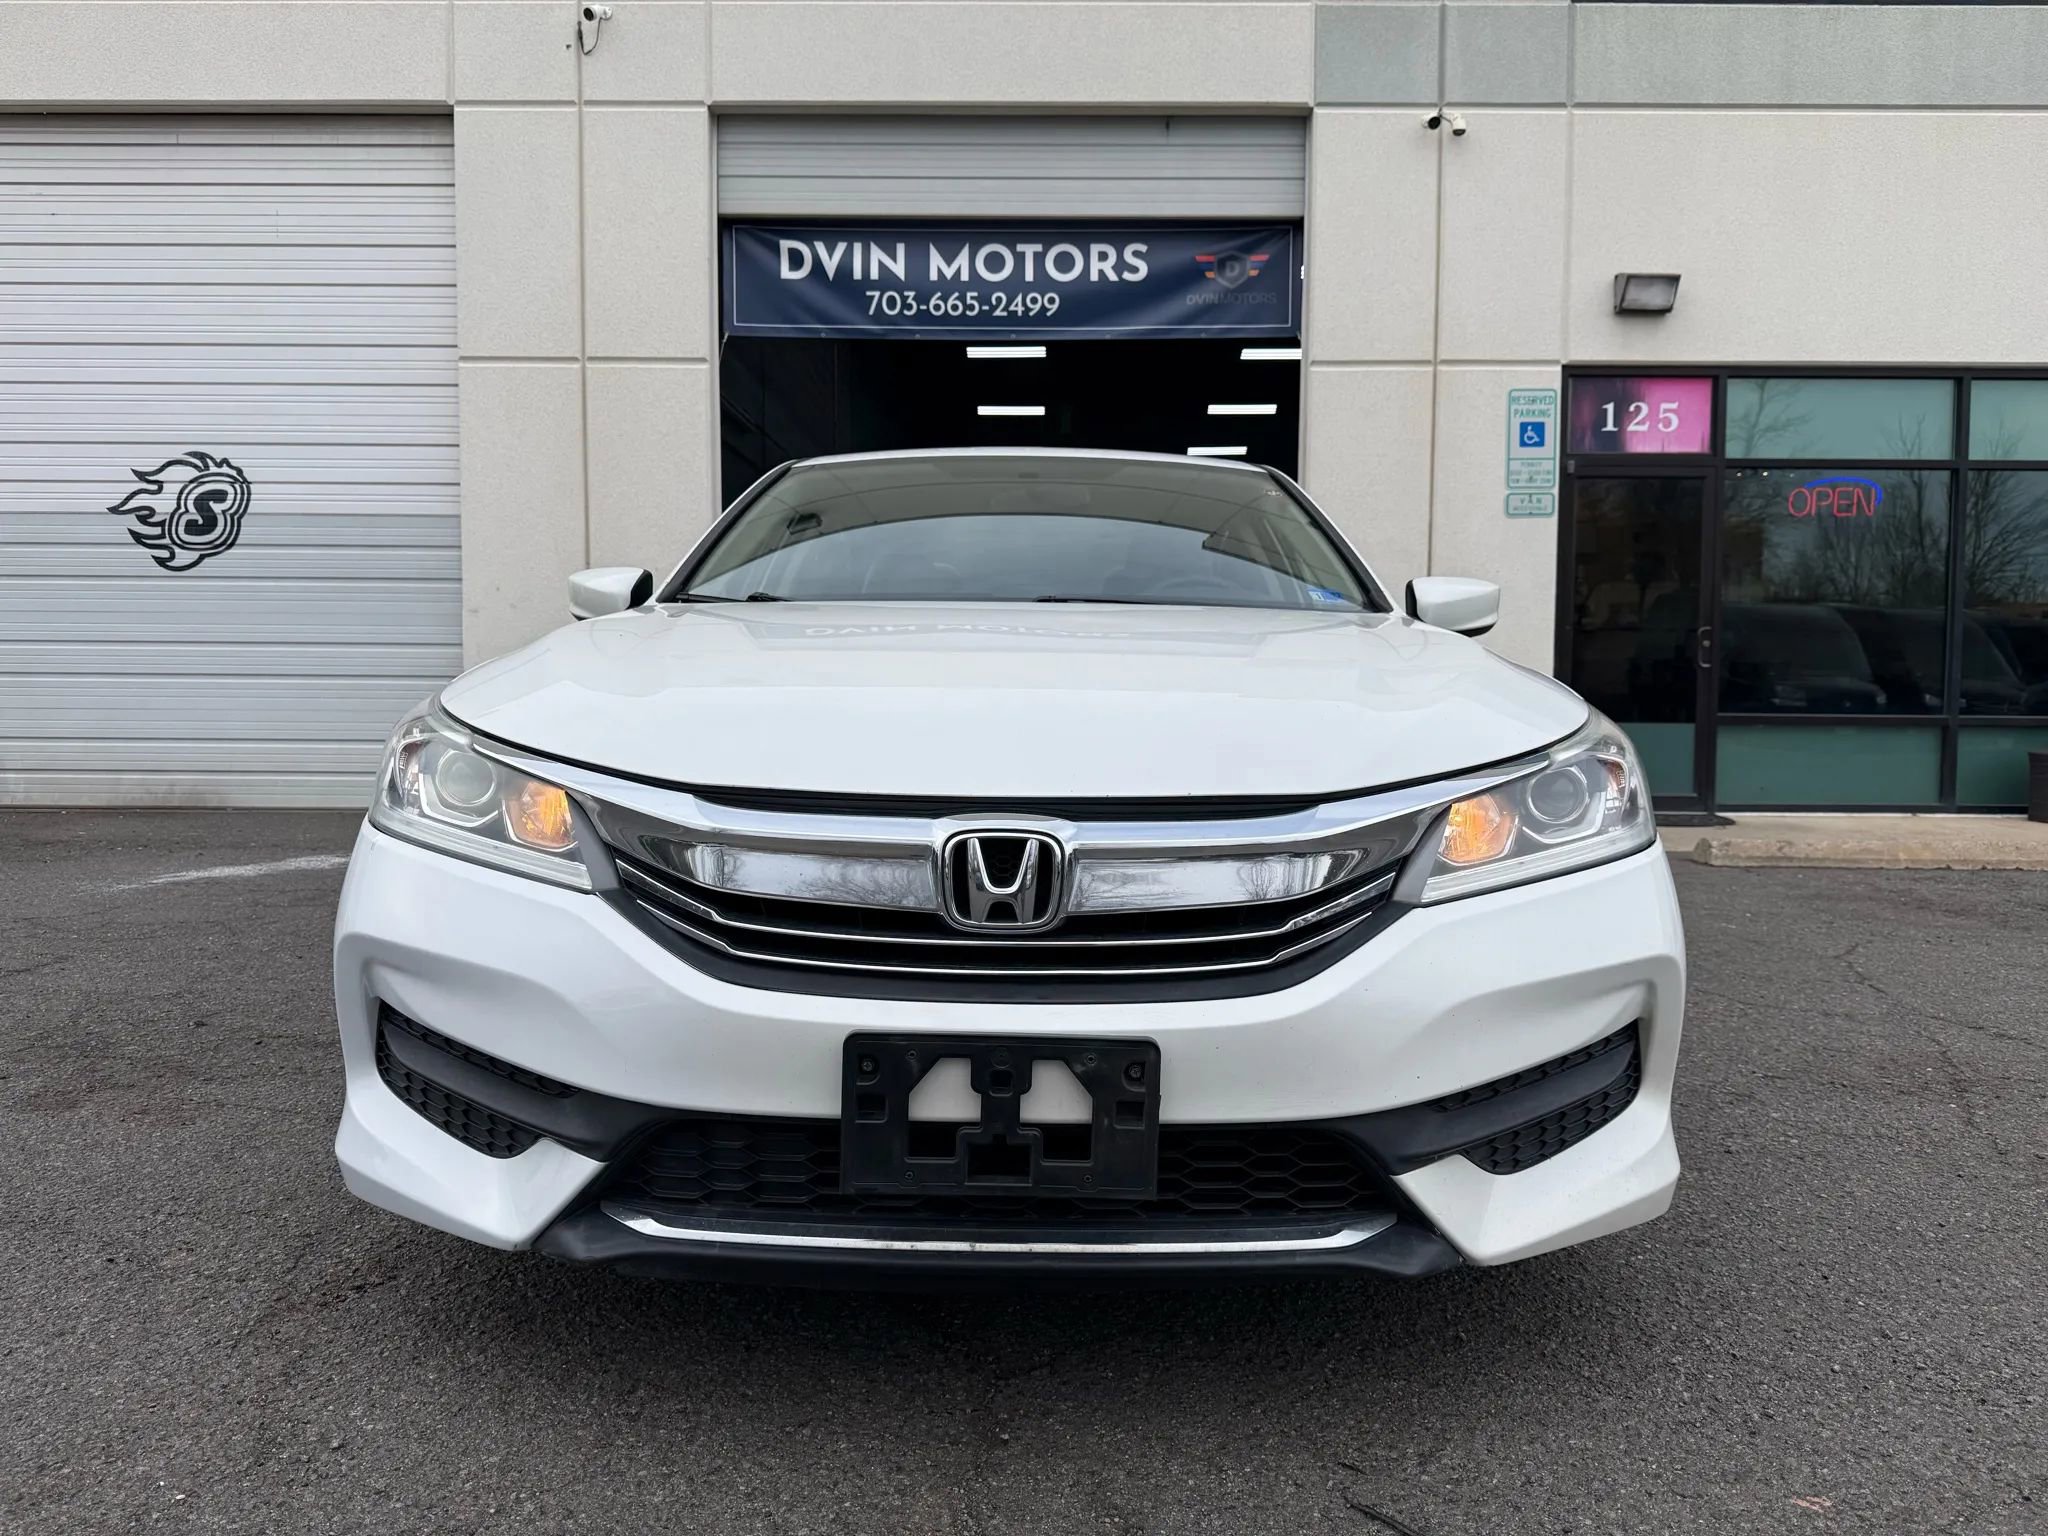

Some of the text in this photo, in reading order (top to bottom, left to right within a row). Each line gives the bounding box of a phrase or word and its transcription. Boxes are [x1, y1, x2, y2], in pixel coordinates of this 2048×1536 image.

[779, 239, 1149, 283] DVIN MOTORS
[865, 290, 1061, 317] 703-665-2499
[1511, 395, 1554, 406] RESERVED
[1513, 408, 1552, 418] PARKING
[1600, 401, 1680, 432] 125
[1788, 487, 1876, 517] OPEN
